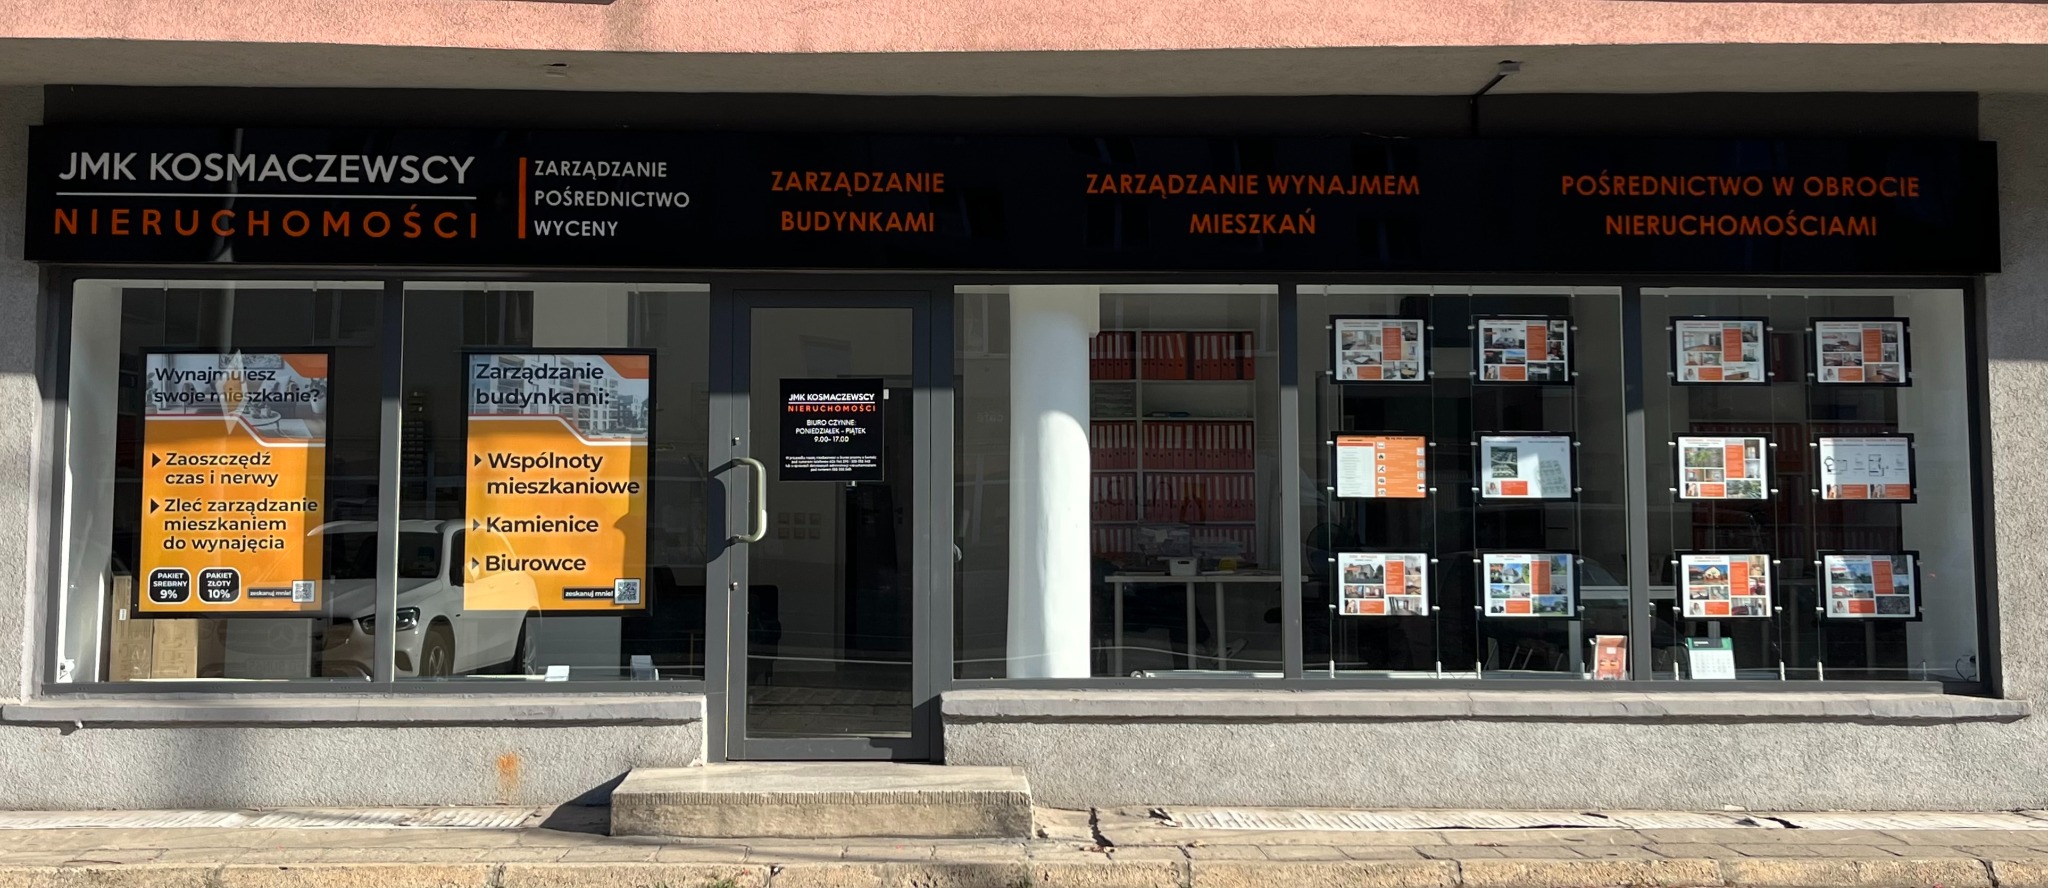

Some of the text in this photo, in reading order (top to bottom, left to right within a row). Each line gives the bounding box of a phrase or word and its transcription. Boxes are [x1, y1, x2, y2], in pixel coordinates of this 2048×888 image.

[59, 152, 476, 184] JMK KOSMACZEWSCY
[534, 160, 667, 182] ZARZĄDZANIE
[772, 171, 944, 197] ZARZĄDZANIE
[1087, 174, 1420, 199] ZARZĄDZANIE WYNAJMEM
[1562, 170, 1920, 197] POŚREDNICTWO W OBROCIE
[534, 189, 690, 207] POŚREDNICTWO
[55, 204, 478, 238] NIERUCHOMOŚCI
[534, 220, 618, 237] WYCENY
[782, 211, 935, 232] BUDYNKAMI
[1189, 209, 1316, 234] MIESZKAŃ
[1606, 210, 1877, 236] NIERUCHOMOŚCIAMI
[155, 367, 276, 383] Wynajmujesz
[476, 363, 603, 383] Zarządzanie
[154, 388, 319, 404] swoje mieszkanie?
[476, 388, 609, 407] budynkami:
[788, 404, 875, 412] NIERUCHOMOŚCI
[166, 452, 271, 469] Zaoszczędź
[488, 452, 603, 472] Wspólnoty
[165, 471, 278, 487] czas i nerwy
[488, 478, 639, 494] mieszkaniowe
[165, 499, 318, 515] Zleć zarządzanie
[165, 517, 286, 531] mieszkaniem
[487, 516, 598, 532] Kamienice
[164, 536, 284, 553] do wynajęcia
[486, 555, 586, 571] Biurowce
[160, 589, 177, 599] 9%
[208, 589, 230, 599] 10%
